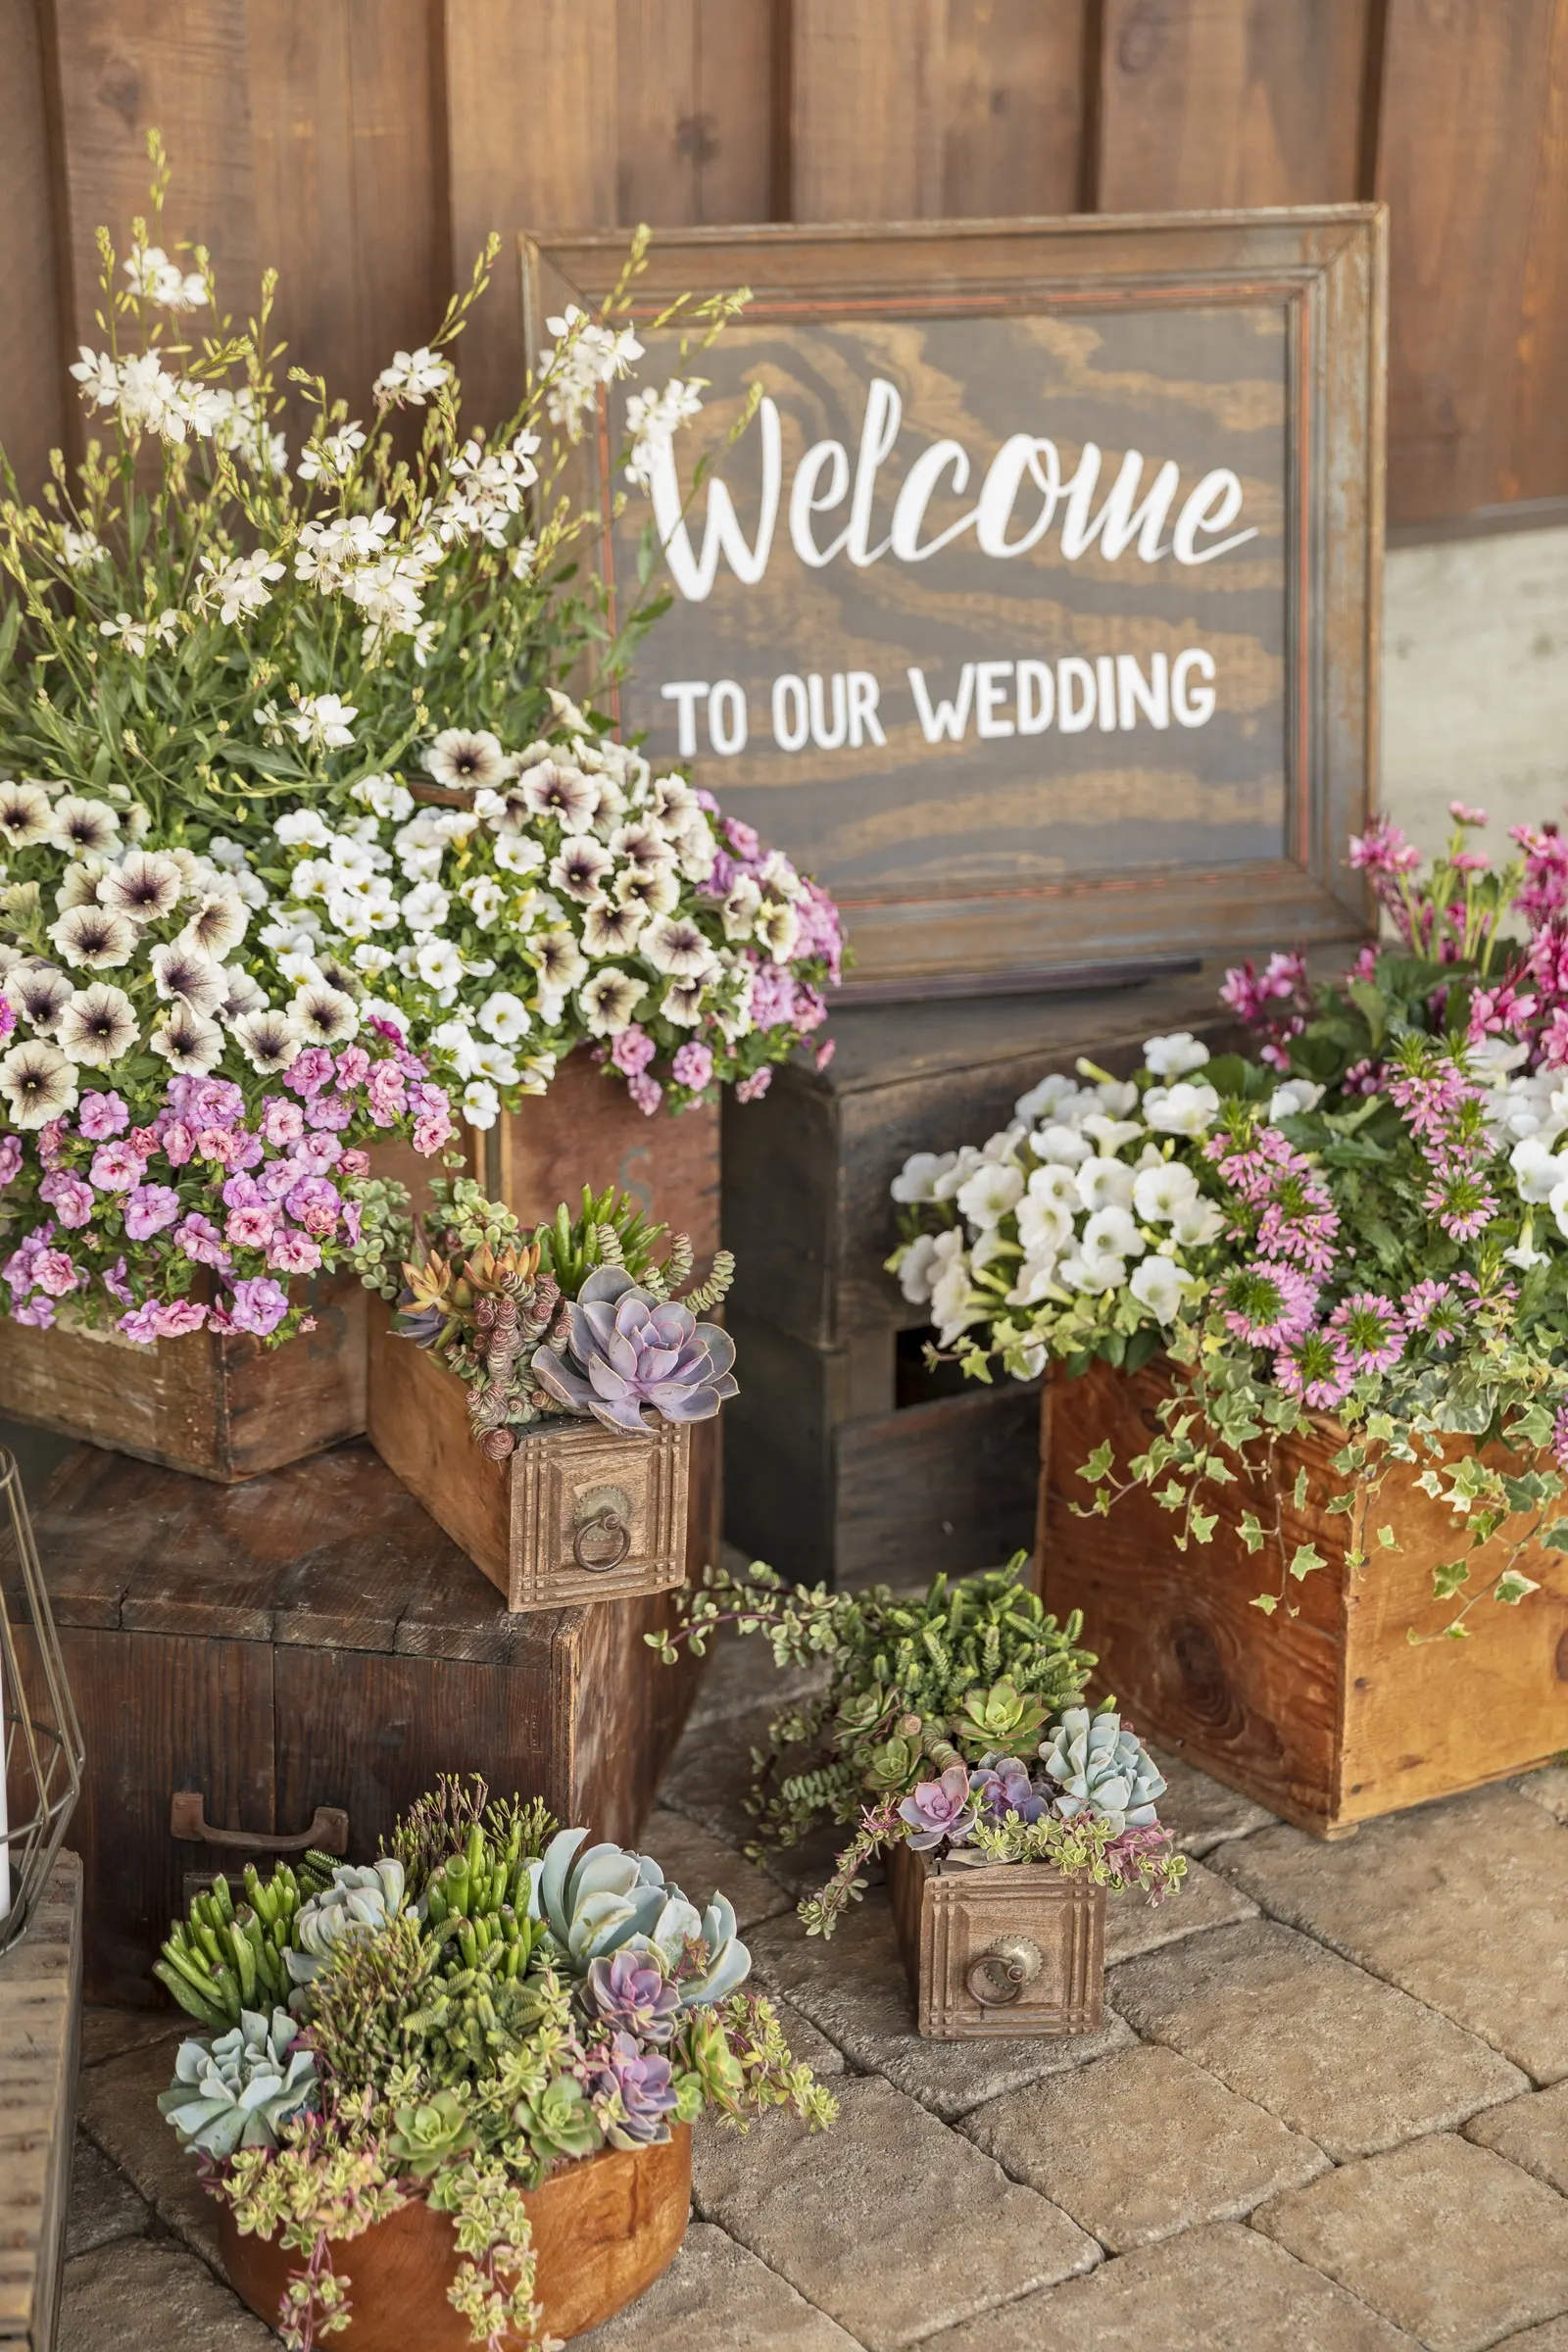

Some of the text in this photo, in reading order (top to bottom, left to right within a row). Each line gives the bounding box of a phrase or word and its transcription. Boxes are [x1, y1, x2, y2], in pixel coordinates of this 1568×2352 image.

[649, 378, 1258, 601] Welcome
[662, 648, 1217, 758] TO OUR WEDDING
